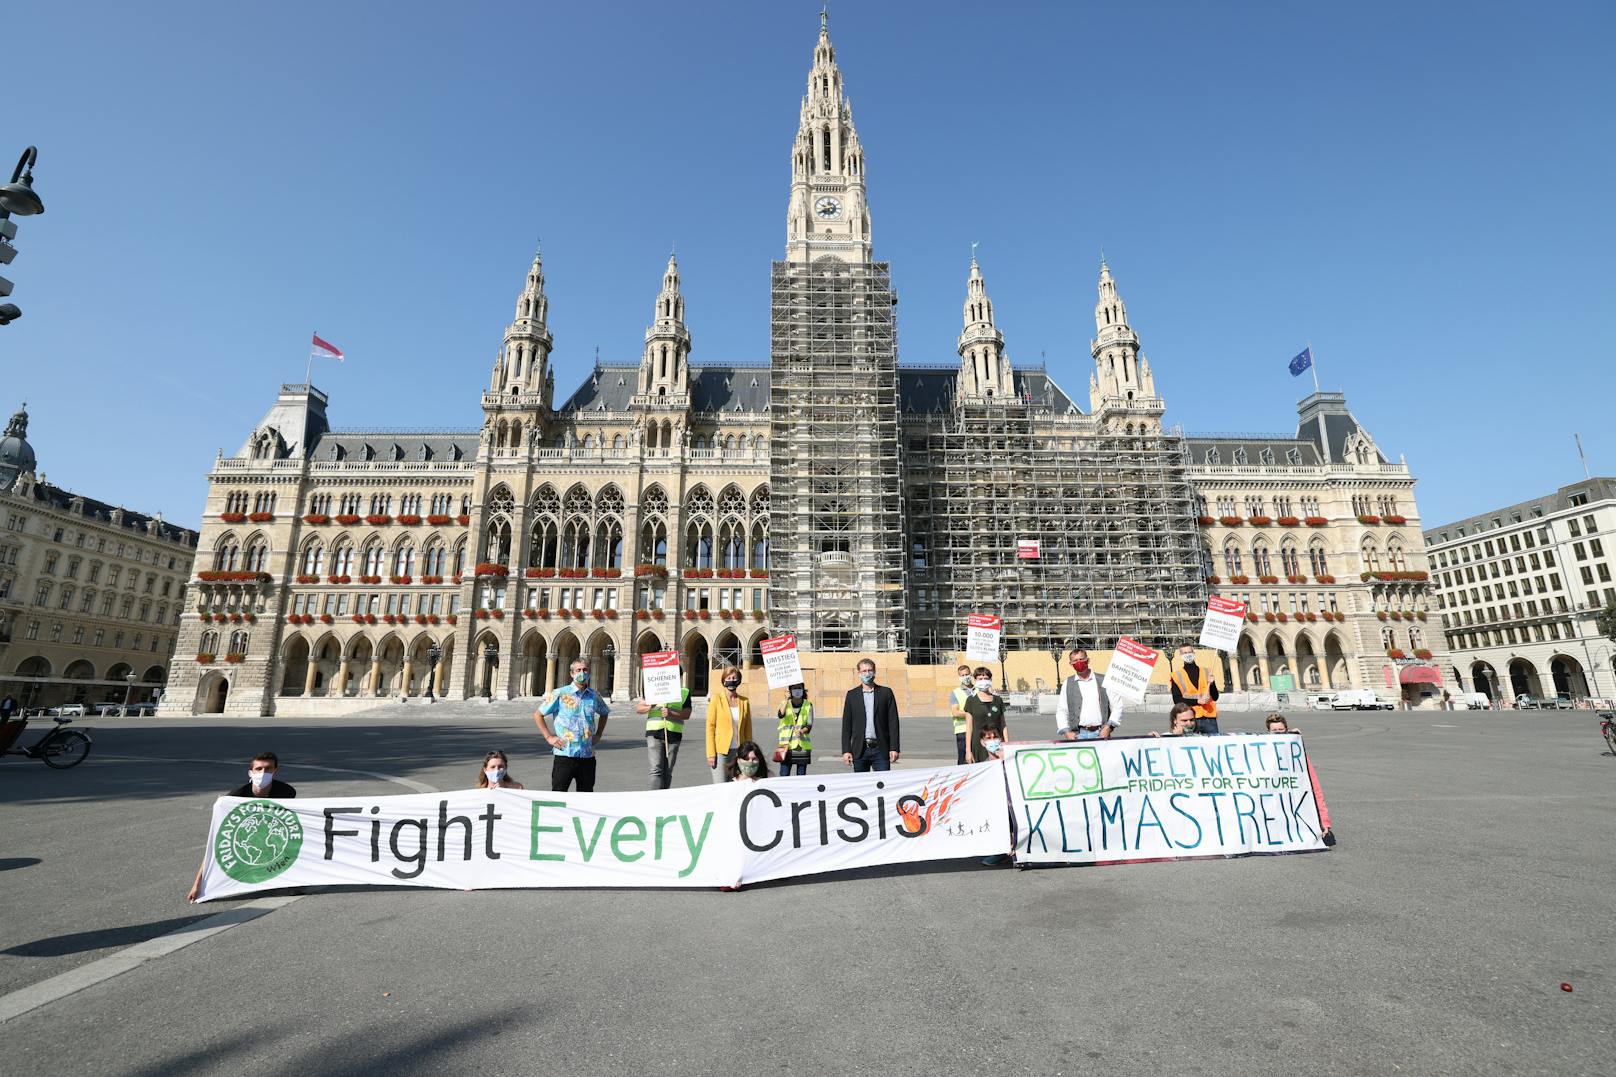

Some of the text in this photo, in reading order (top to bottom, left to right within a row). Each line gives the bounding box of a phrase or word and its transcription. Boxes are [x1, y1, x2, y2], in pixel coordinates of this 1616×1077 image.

[766, 652, 795, 664] UMSTIEG
[1112, 662, 1148, 682] BAHNSTROM
[648, 674, 676, 682] SCHIENEN
[1120, 742, 1304, 778] WELTWEITER
[1128, 776, 1299, 792] FRIDAYS FOR FUTURE
[218, 802, 300, 870] FRIDAYS FOR FUTURE
[324, 782, 926, 879] Fight Every Crisis
[1024, 790, 1318, 854] KLIMASTREIK
